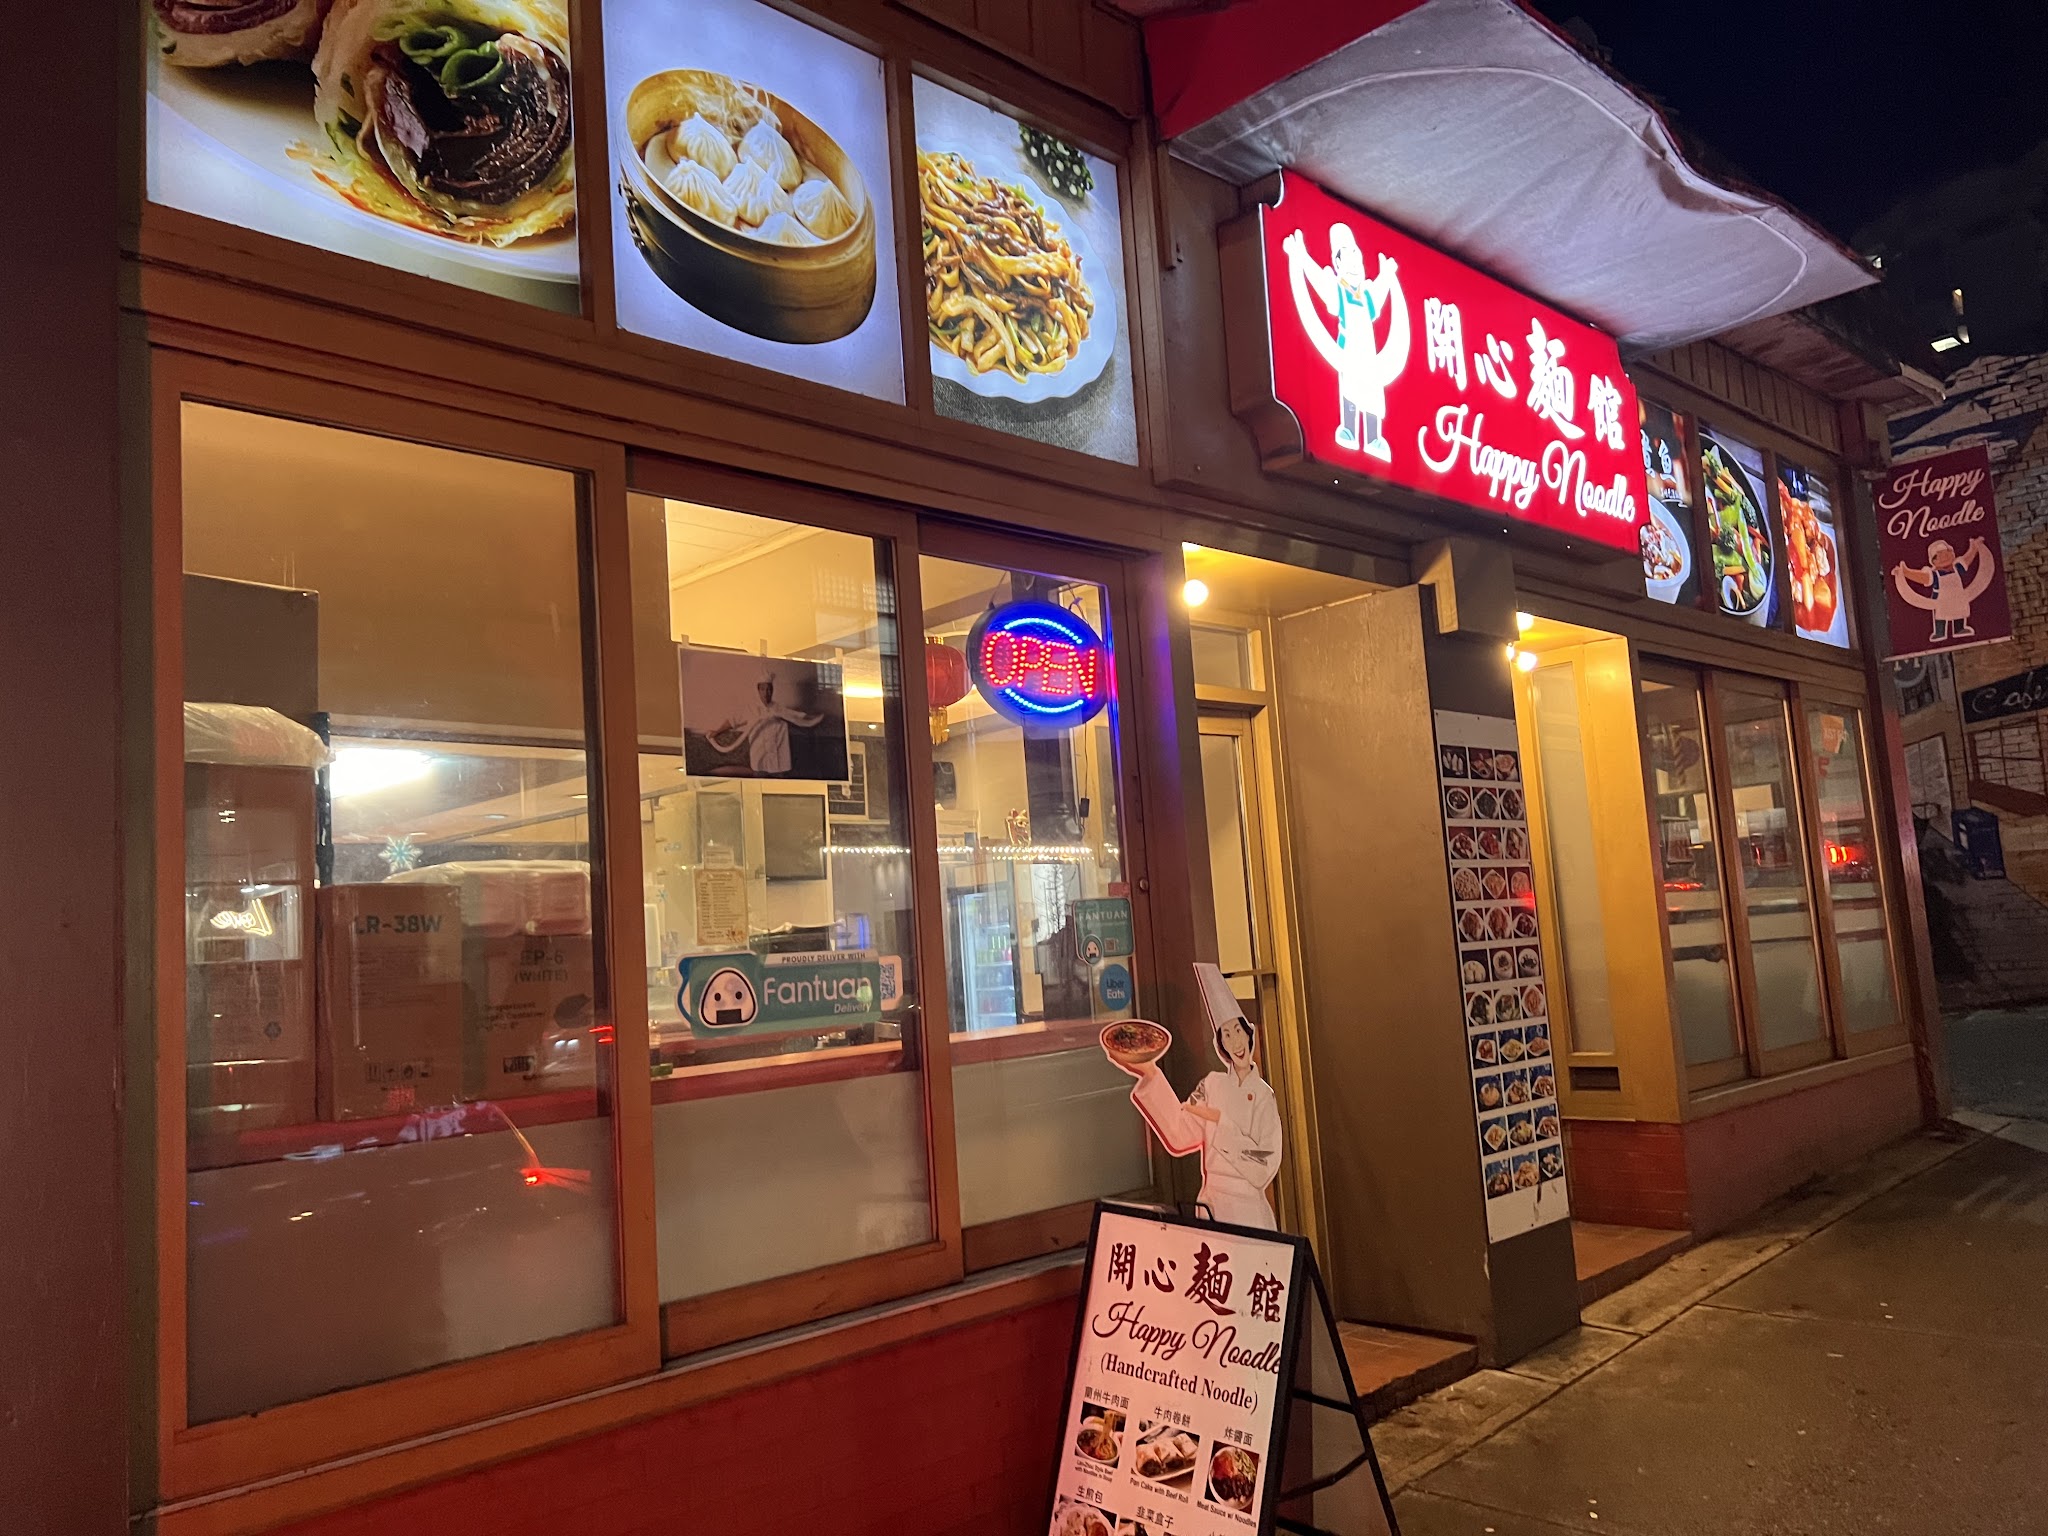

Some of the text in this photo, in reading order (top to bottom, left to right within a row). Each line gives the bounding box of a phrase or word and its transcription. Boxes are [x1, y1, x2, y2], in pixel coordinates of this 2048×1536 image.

[1424, 297, 1625, 451] 開心麵館
[1418, 404, 1539, 509] Happy
[1541, 440, 1636, 522] Noodle
[1879, 466, 1985, 509] Happy
[1887, 499, 1985, 540] Noodle
[984, 630, 1096, 700] OPEN
[355, 915, 442, 935] LR-38W
[1079, 909, 1128, 921] FANTUAN
[781, 952, 866, 964] PROUDLY DELIVER WITH
[763, 975, 871, 1005] Fantuan
[1106, 979, 1124, 989] Uber
[1106, 989, 1125, 1000] Eats
[834, 1001, 871, 1014] Delivery
[1108, 1242, 1285, 1322] 開心麵館
[1092, 1301, 1281, 1375] Happy Noodle
[1100, 1352, 1258, 1415] (Handcrafted Noodle)
[1154, 1486, 1165, 1495] with
[1166, 1489, 1178, 1500] Beef
